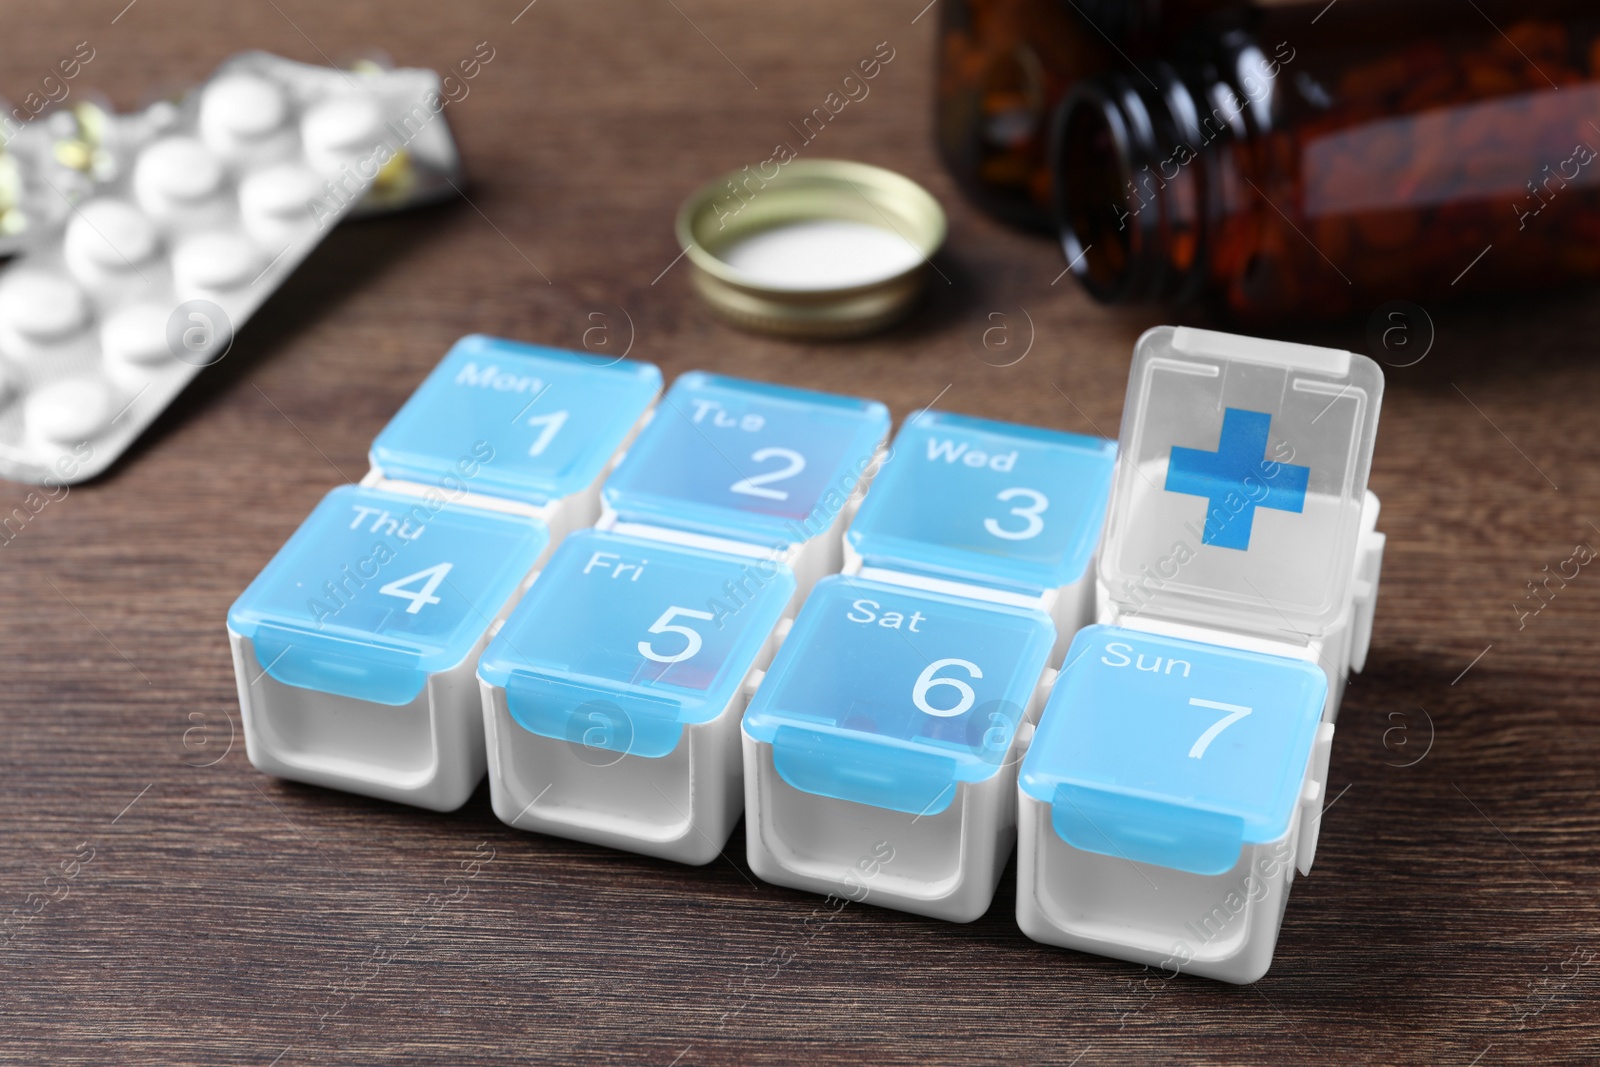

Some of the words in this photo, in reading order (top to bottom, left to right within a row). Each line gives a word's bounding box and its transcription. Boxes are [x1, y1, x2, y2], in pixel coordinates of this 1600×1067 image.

[455, 361, 544, 394] Mon
[527, 409, 570, 457] 1
[926, 436, 1019, 473] Wed
[729, 446, 806, 501] 2
[349, 505, 425, 541] Thu
[983, 487, 1049, 540] 3
[378, 561, 454, 614] 4
[583, 551, 648, 582] Fri
[637, 605, 715, 663] 5
[846, 599, 926, 633] Sat
[1101, 642, 1191, 677] Sun
[912, 658, 983, 718] 6
[1188, 697, 1252, 759] 7
